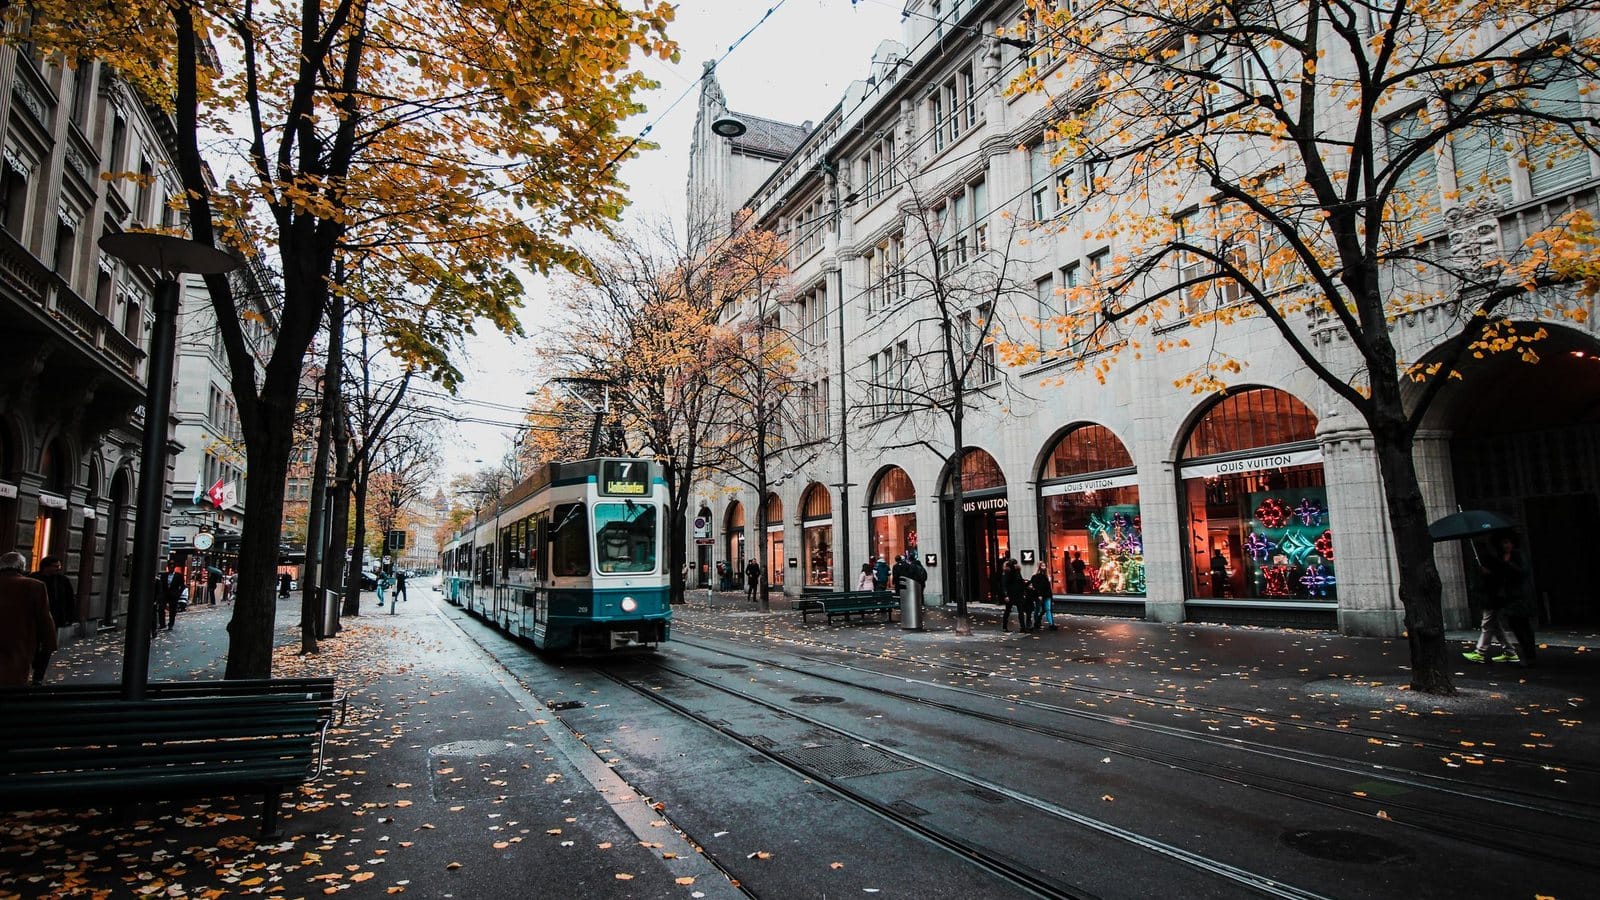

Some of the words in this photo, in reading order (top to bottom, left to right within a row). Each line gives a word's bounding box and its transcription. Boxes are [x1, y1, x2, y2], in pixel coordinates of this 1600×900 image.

[620, 462, 632, 478] 7
[1216, 461, 1244, 473] LOUIS
[1247, 455, 1291, 468] VUITTON
[1064, 482, 1083, 492] LOUIS
[1084, 479, 1113, 489] VUITTON
[961, 501, 976, 512] UIS
